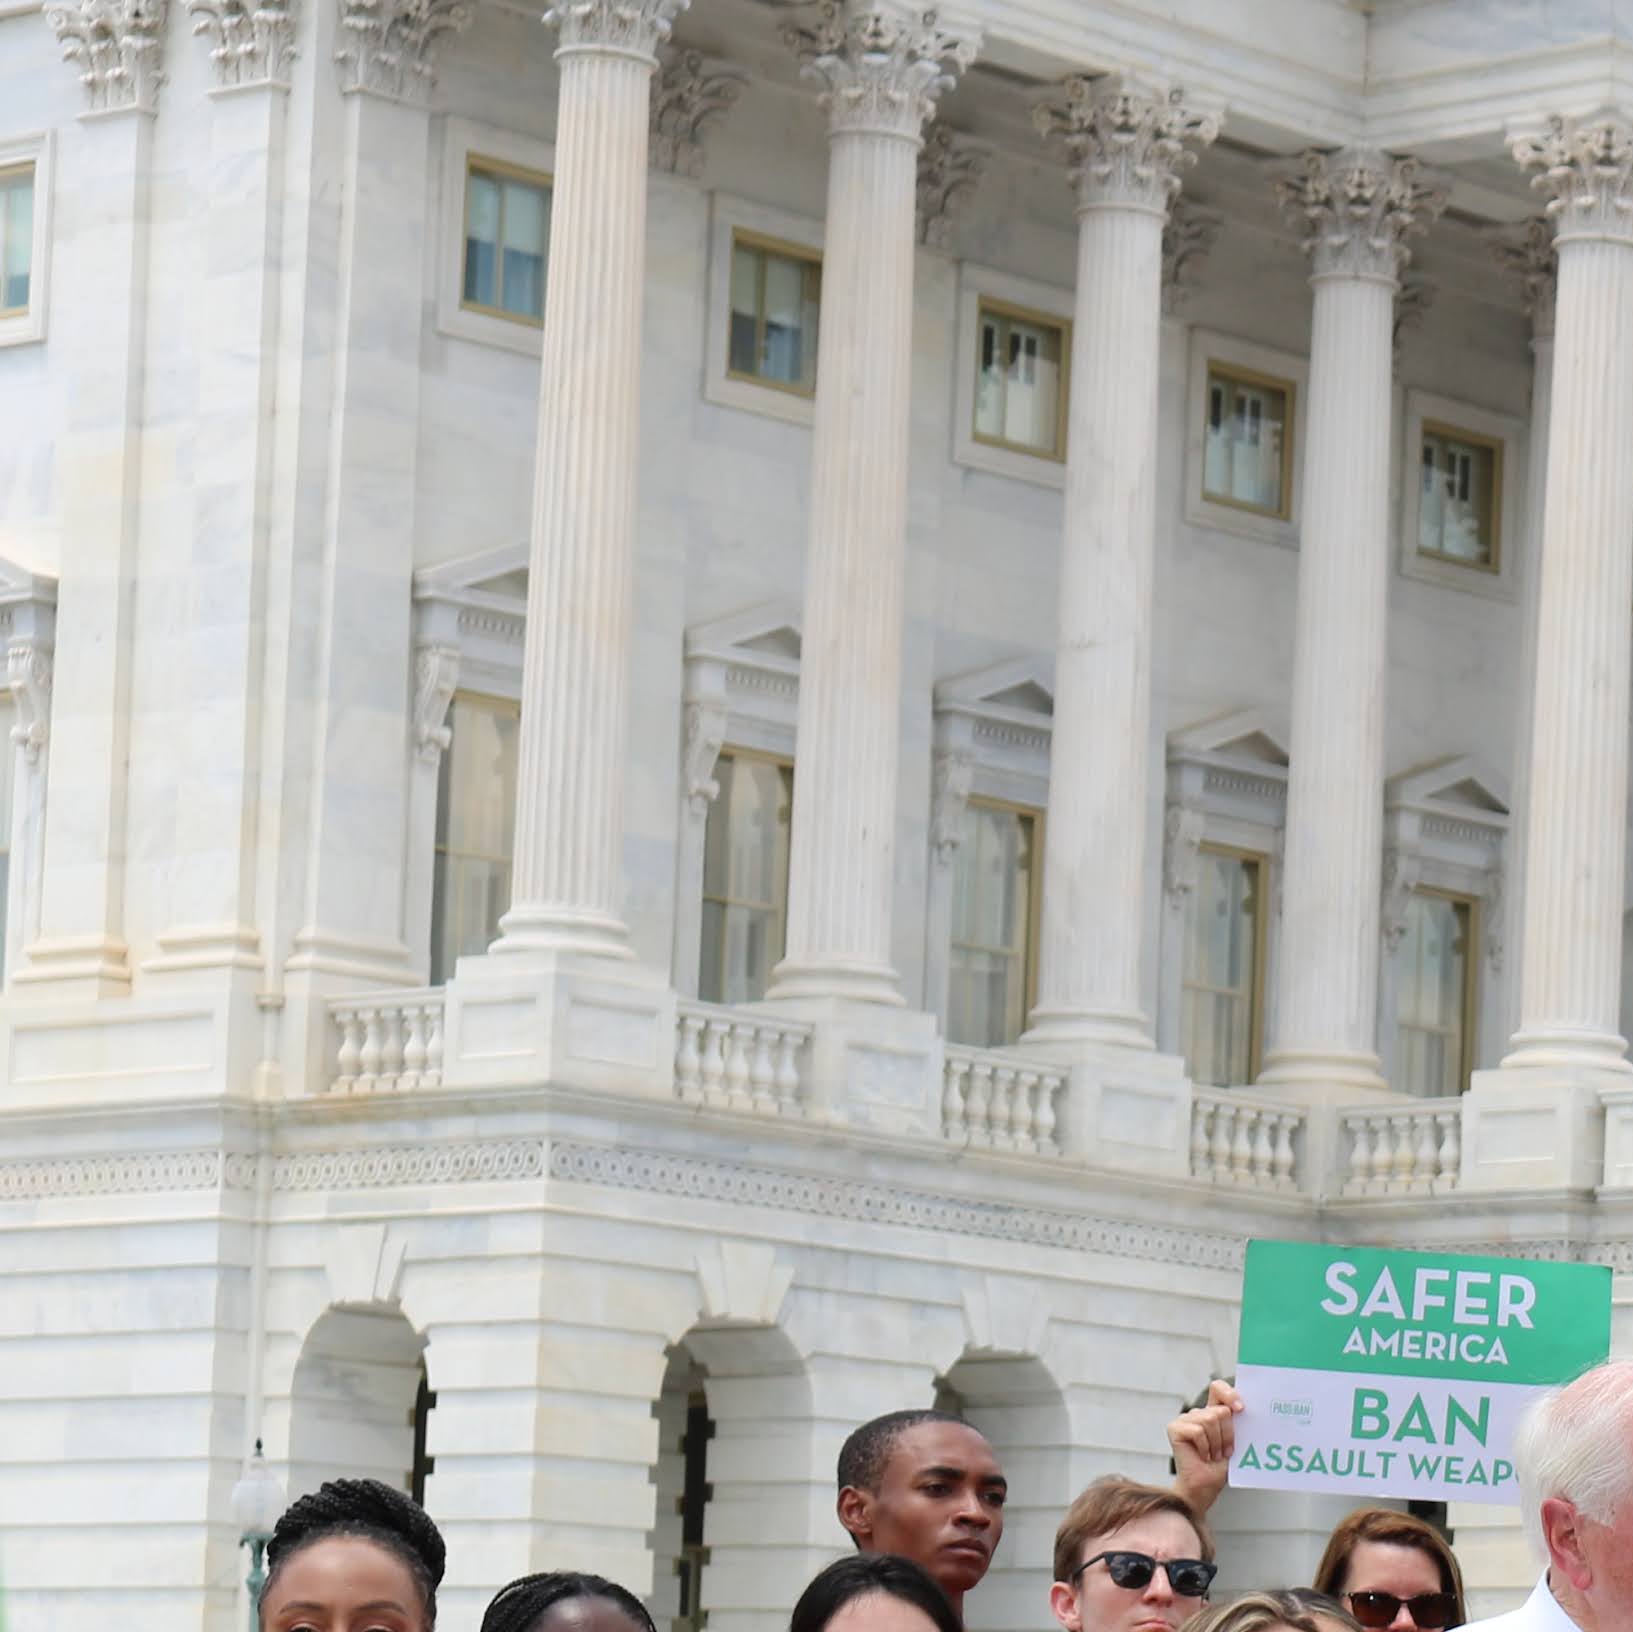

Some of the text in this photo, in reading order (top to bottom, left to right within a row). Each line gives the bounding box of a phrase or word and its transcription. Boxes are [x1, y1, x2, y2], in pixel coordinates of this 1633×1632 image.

[1320, 1261, 1537, 1329] SAFER
[1342, 1326, 1509, 1365] AMERICA
[1350, 1388, 1490, 1448] BAN
[1238, 1443, 1520, 1487] ASSAULT WEAP
